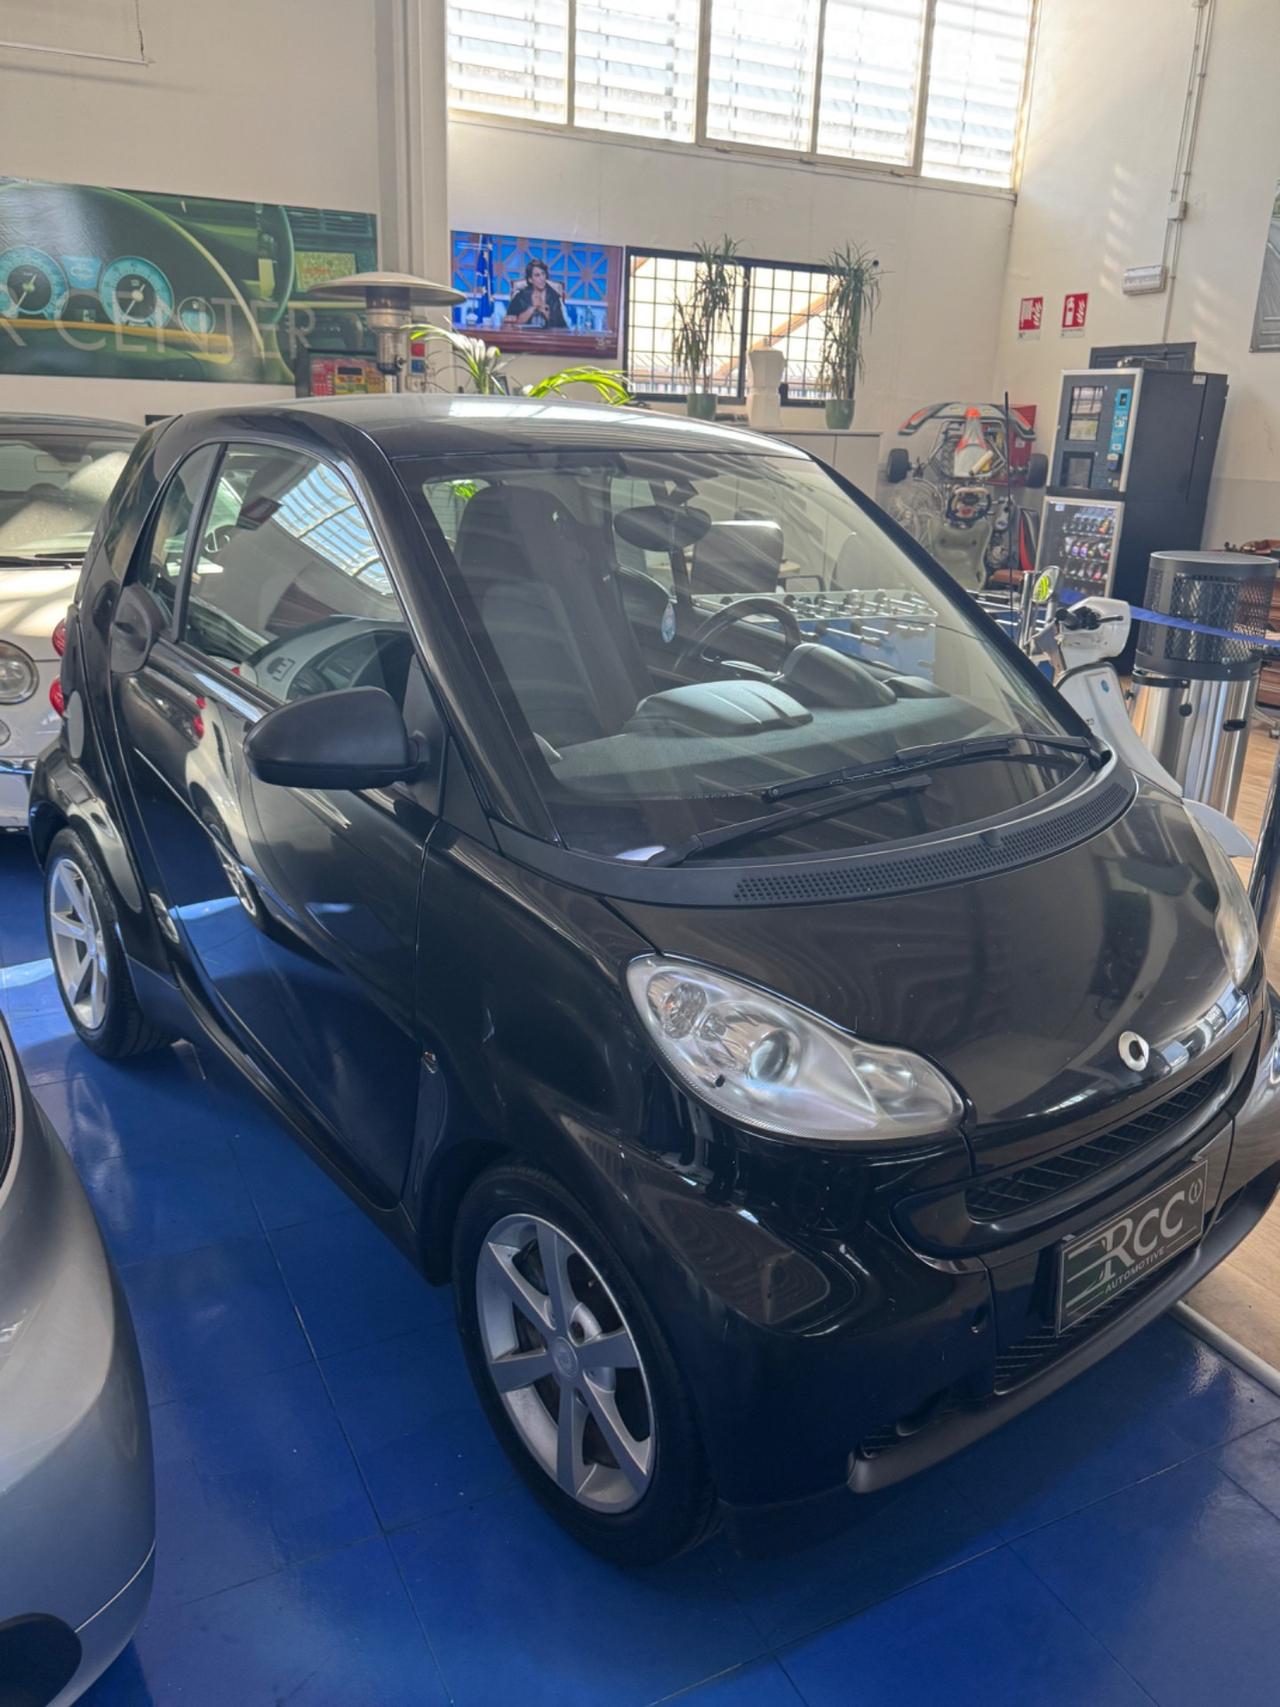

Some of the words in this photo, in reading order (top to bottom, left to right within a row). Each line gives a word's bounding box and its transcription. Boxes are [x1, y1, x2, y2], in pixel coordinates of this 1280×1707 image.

[54, 289, 316, 359] CENTER
[1098, 1190, 1185, 1282] RCC
[1104, 1246, 1165, 1294] AUTOMOTIVE
